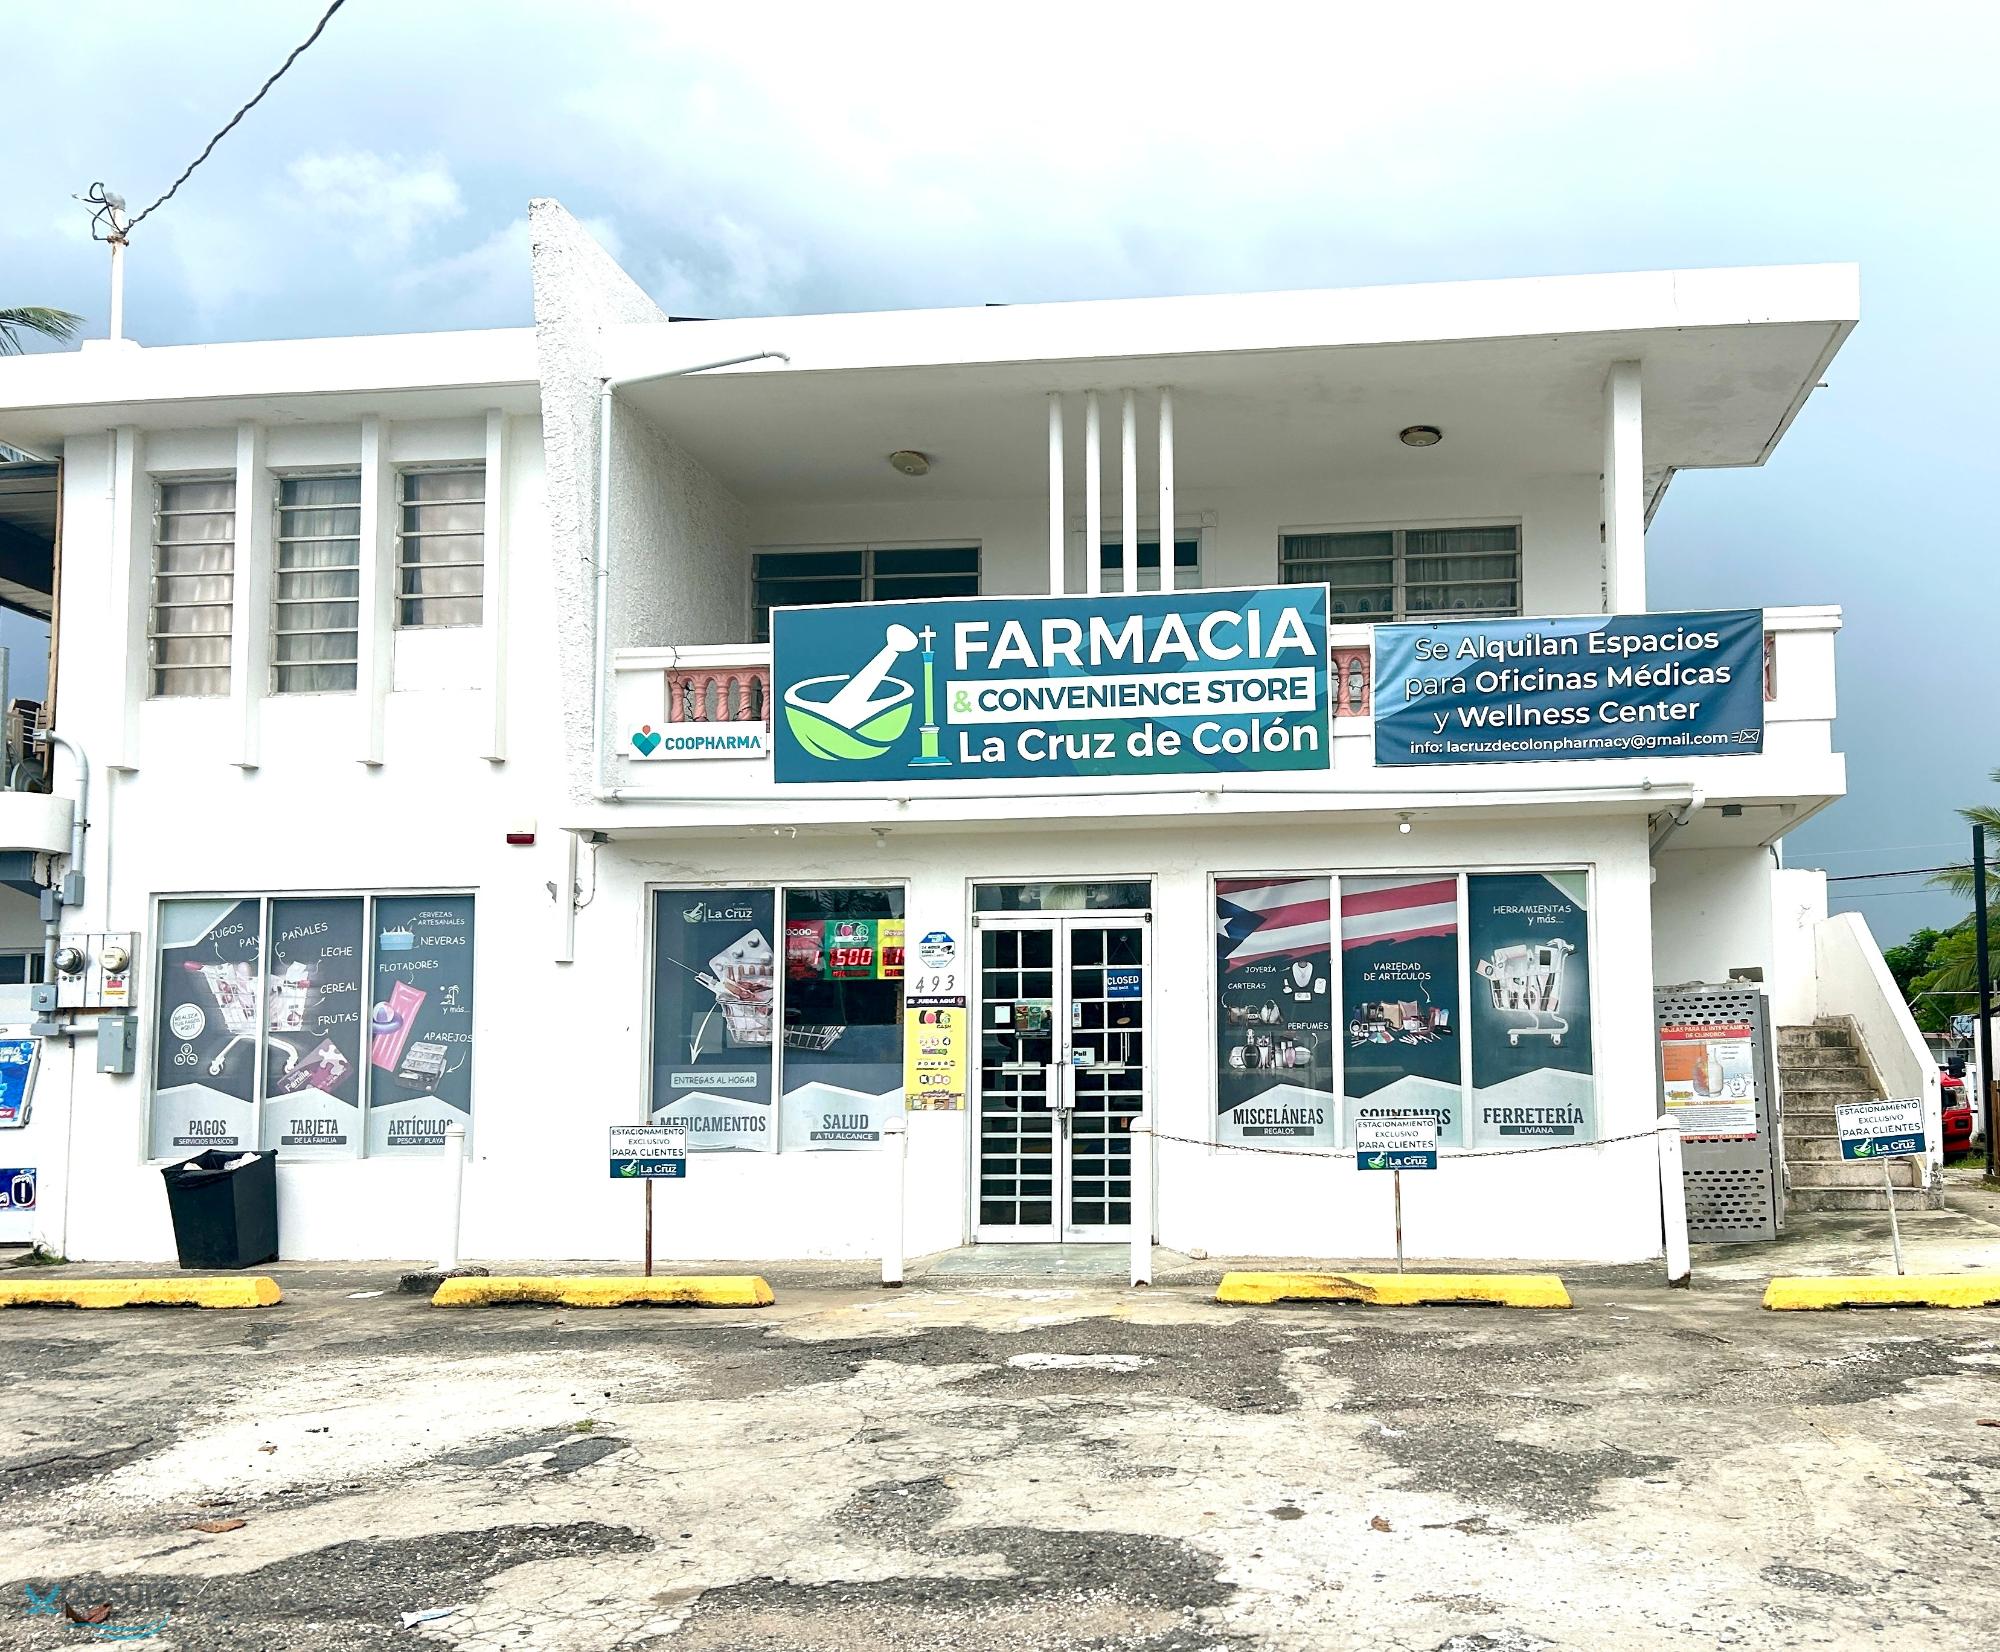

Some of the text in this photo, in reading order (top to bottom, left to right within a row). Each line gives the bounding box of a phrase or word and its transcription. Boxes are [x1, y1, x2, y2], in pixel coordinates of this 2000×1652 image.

[954, 606, 1317, 671] FARMACIA
[1415, 627, 1719, 663] Se Alquilan Espacios
[1405, 661, 1731, 701] para Oficinas Médicas
[953, 676, 1308, 714] & CONVENIENCE STORE
[1433, 698, 1700, 735] y Wellness Center
[665, 736, 761, 750] COOPHARMA
[958, 717, 1319, 764] La Cruz de Colón
[1410, 732, 1728, 755] info: lacruzdecolonpharmacy@gmail.com
[708, 908, 753, 919] La Cruz
[1493, 905, 1572, 914] HERRAMIENTAS
[418, 918, 465, 926] ARTESANALES
[1528, 916, 1533, 926] y
[209, 923, 244, 941] JUGOS
[282, 922, 328, 941] PAÑALES
[420, 936, 466, 946] NEVERAS
[321, 947, 353, 957] LECHE
[837, 949, 873, 965] 500
[379, 960, 439, 972] FLOTADORES
[1107, 976, 1139, 985] CLOSED
[1364, 970, 1431, 981] DE ARTÍCULOS
[320, 983, 357, 994] CEREAL
[443, 1007, 447, 1015] y
[318, 1013, 359, 1026] FRUTAS
[1288, 1022, 1329, 1030] PERFUMES
[424, 1032, 473, 1043] APAREJOS
[674, 1075, 755, 1085] ENTREGAS AL HOGAR
[1483, 1103, 1584, 1124] FERRETERÍA
[1840, 1102, 1918, 1115] ESTACIONAMIENTO
[1233, 1104, 1324, 1125] MISCELÁNEAS
[1858, 1114, 1904, 1124] EXCLUSIVO
[290, 1119, 339, 1136] TARJETA
[822, 1114, 869, 1130] SALUD
[189, 1120, 227, 1136] PAGOS
[612, 1128, 684, 1136] ESTACIONAMIENTO
[1264, 1127, 1295, 1135] REGALOS
[1519, 1126, 1554, 1134] LIVIANA
[1842, 1123, 1921, 1137] PARA CLIENTES
[178, 1137, 234, 1146] SERVICIOS BÁSICOS
[312, 1136, 336, 1144] FAMILIA
[397, 1137, 444, 1145] PESCA Y PLAYA
[836, 1132, 873, 1140] ALCANCE
[1875, 1143, 1889, 1151] La
[1890, 1141, 1916, 1150] Cruz
[612, 1148, 684, 1157] PARA CLIENTES
[1389, 1157, 1428, 1165] La Cruz
[640, 1164, 677, 1173] La Cruz
